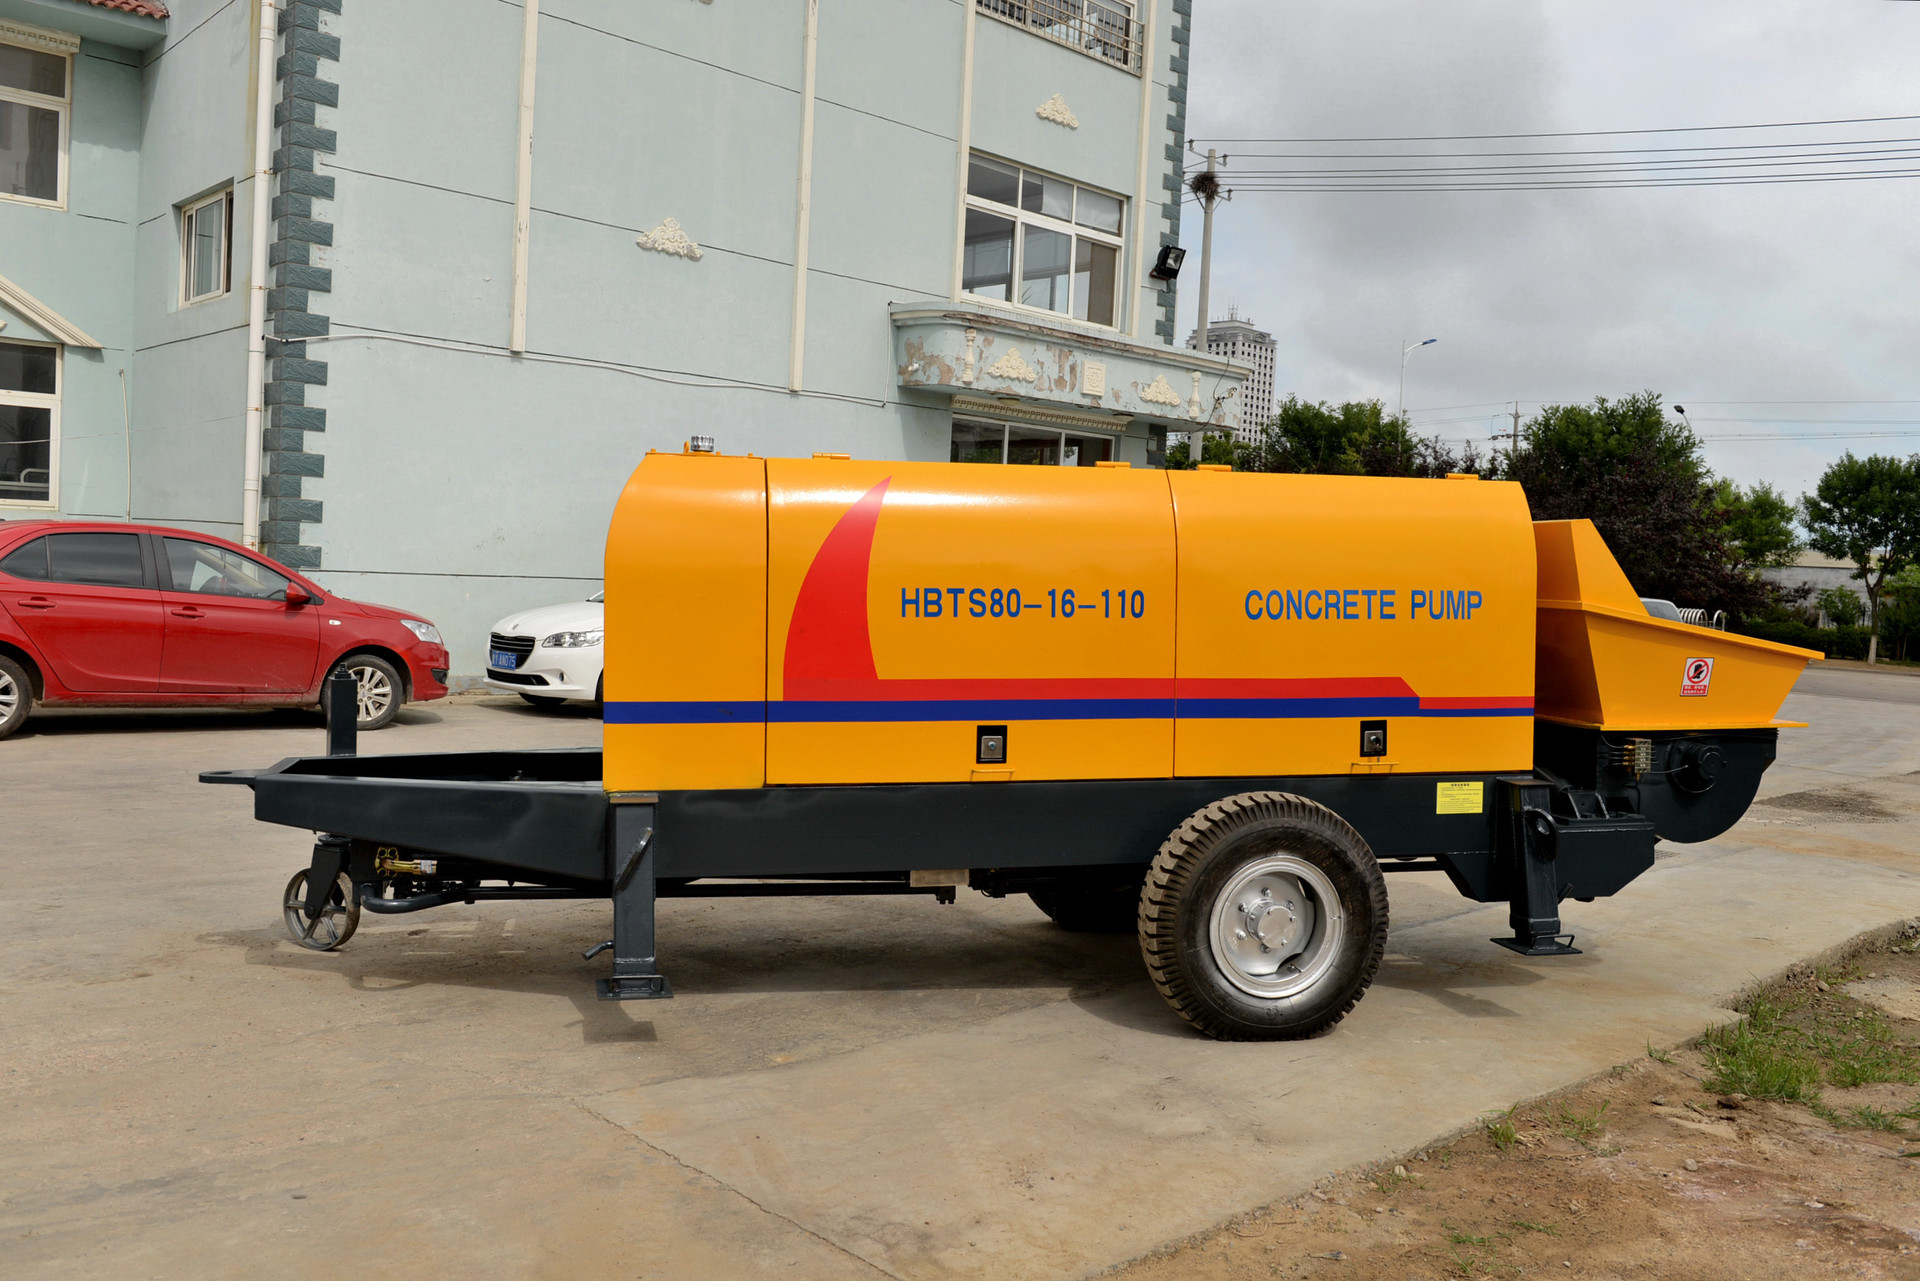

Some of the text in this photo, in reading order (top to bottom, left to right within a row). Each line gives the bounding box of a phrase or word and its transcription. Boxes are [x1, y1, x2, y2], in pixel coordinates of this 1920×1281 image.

[901, 587, 1145, 619] HBTS80-16-110
[1244, 589, 1483, 620] CONCRETE PUMP
